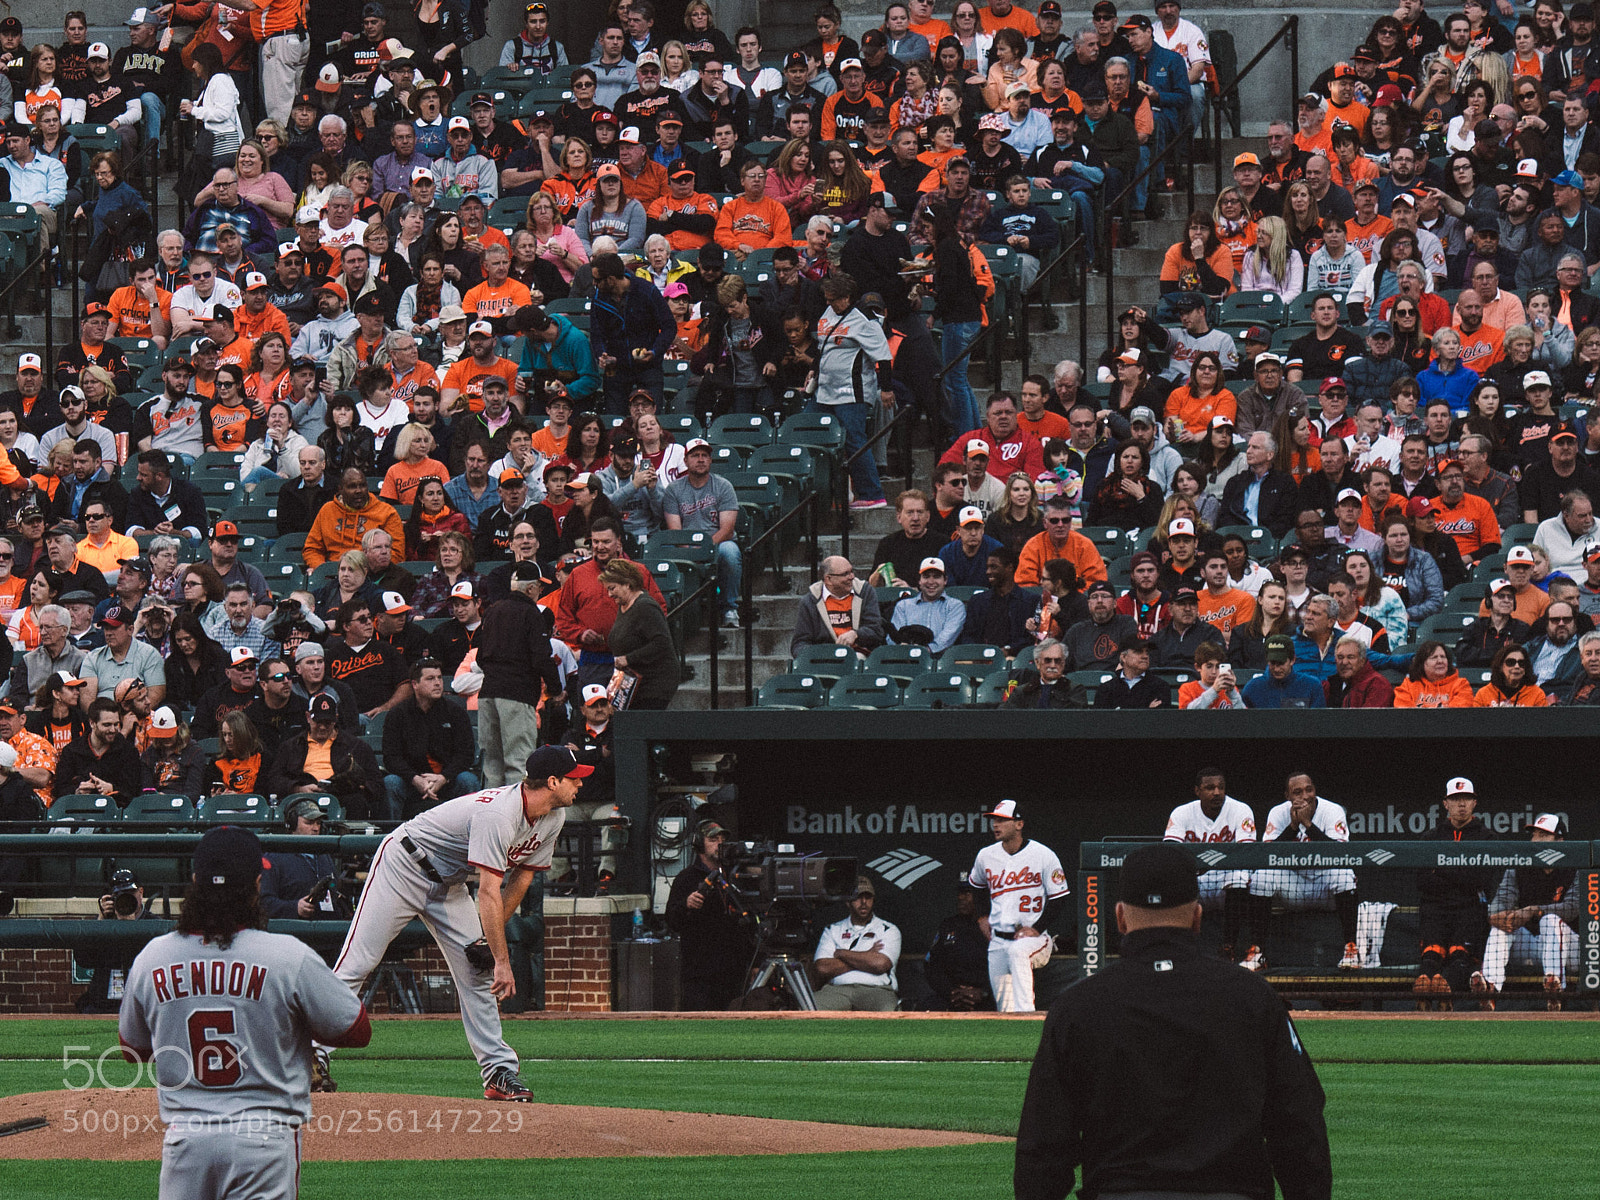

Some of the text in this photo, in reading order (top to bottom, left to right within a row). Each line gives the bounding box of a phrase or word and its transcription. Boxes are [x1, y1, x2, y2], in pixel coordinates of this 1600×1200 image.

[122, 53, 166, 75] ARMY
[1224, 619, 1231, 632] 5
[331, 656, 384, 680] Orioles
[786, 804, 862, 835] Bank
[865, 804, 897, 835] of
[1344, 804, 1404, 834] ank
[1407, 804, 1440, 834] of
[1268, 854, 1363, 866] Bank of America
[1437, 854, 1533, 866] Bank of America
[1018, 896, 1043, 913] 23
[1585, 873, 1600, 989] Orioles.com
[152, 960, 268, 1004] RENDON
[186, 1007, 243, 1089] 6
